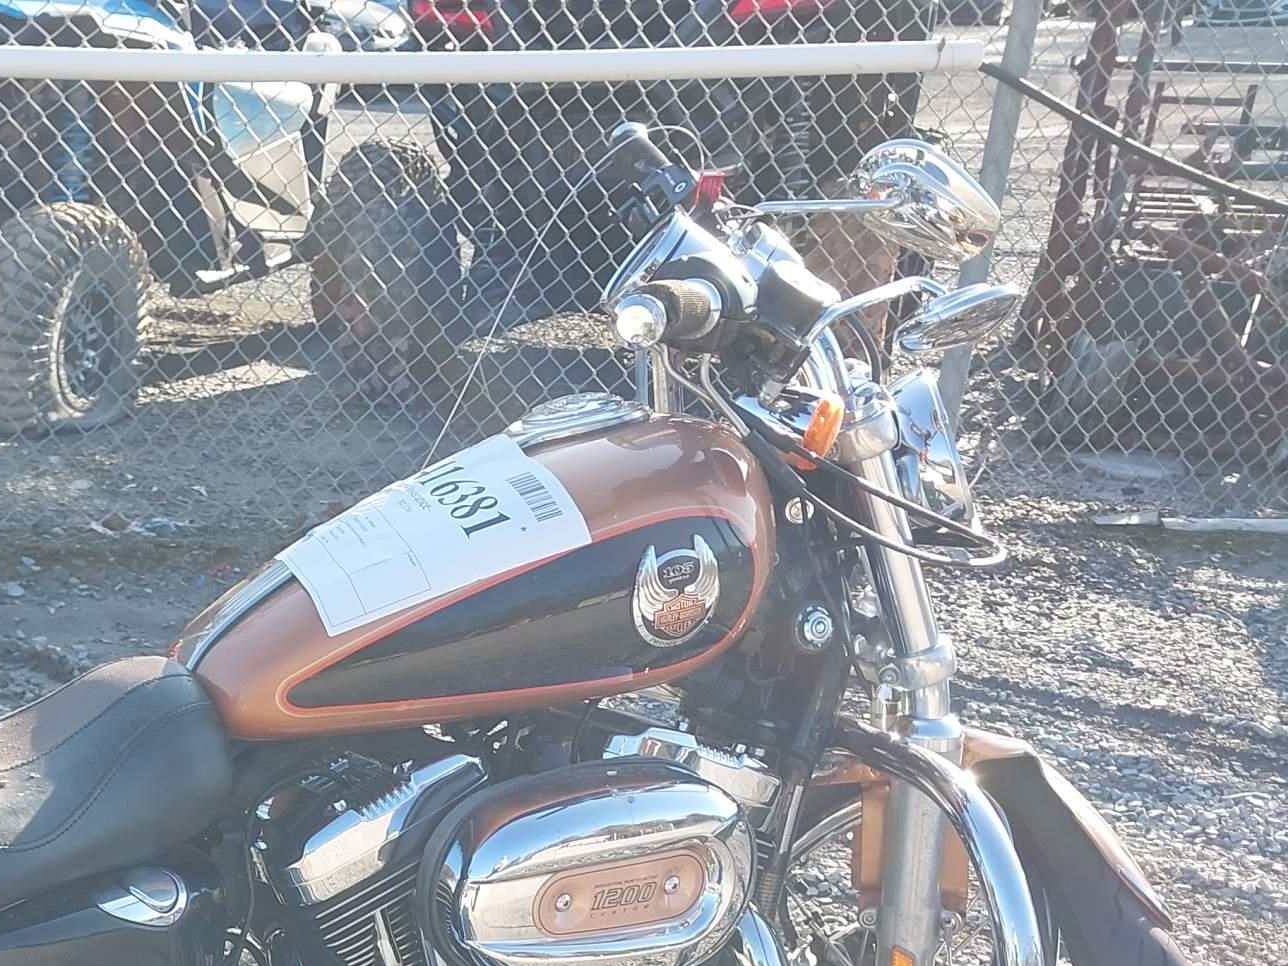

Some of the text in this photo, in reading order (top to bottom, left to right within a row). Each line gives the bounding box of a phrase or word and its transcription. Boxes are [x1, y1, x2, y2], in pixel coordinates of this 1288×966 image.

[663, 561, 695, 579] 105
[591, 882, 657, 911] 1200
[590, 903, 650, 919] CUSTOM
